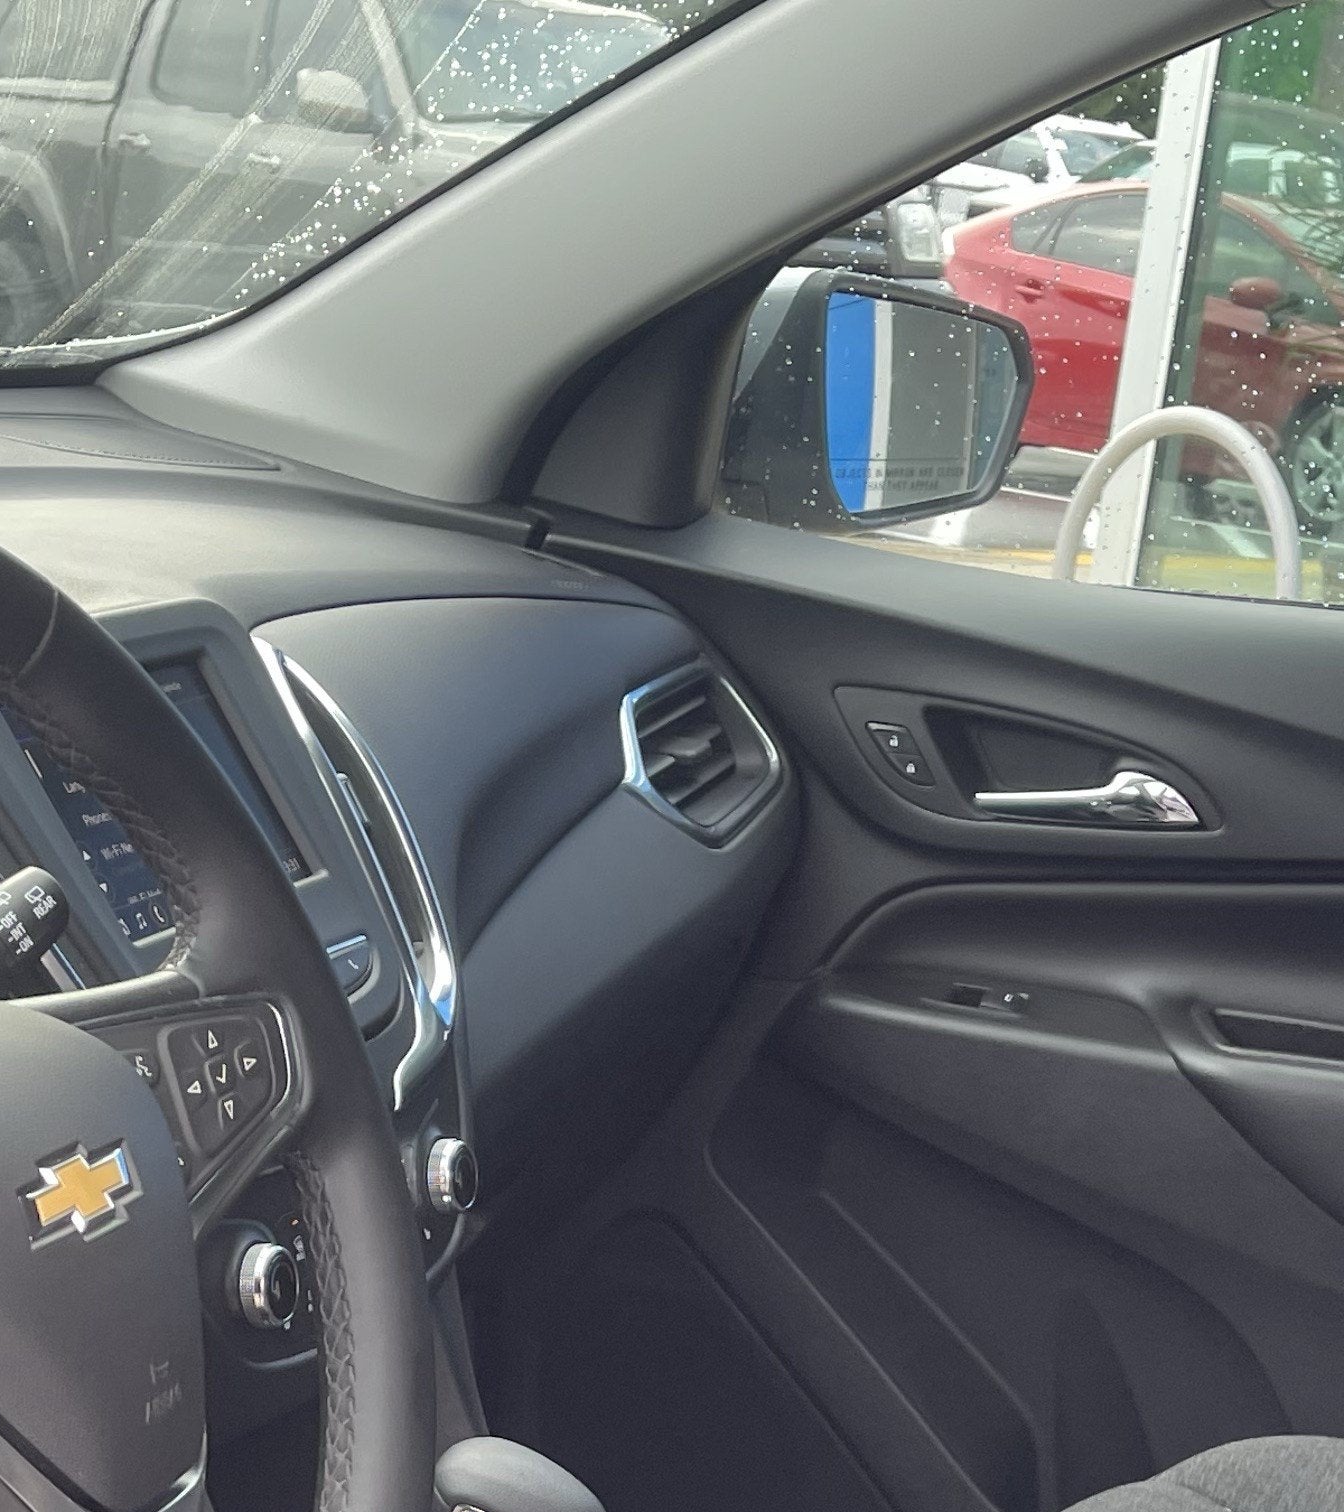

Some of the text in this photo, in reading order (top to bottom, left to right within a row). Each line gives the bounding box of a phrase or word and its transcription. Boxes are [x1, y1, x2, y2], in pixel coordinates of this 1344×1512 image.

[32, 894, 57, 919] REAR
[1, 910, 19, 929] OFF
[9, 922, 28, 941] INT
[17, 934, 34, 952] ON
